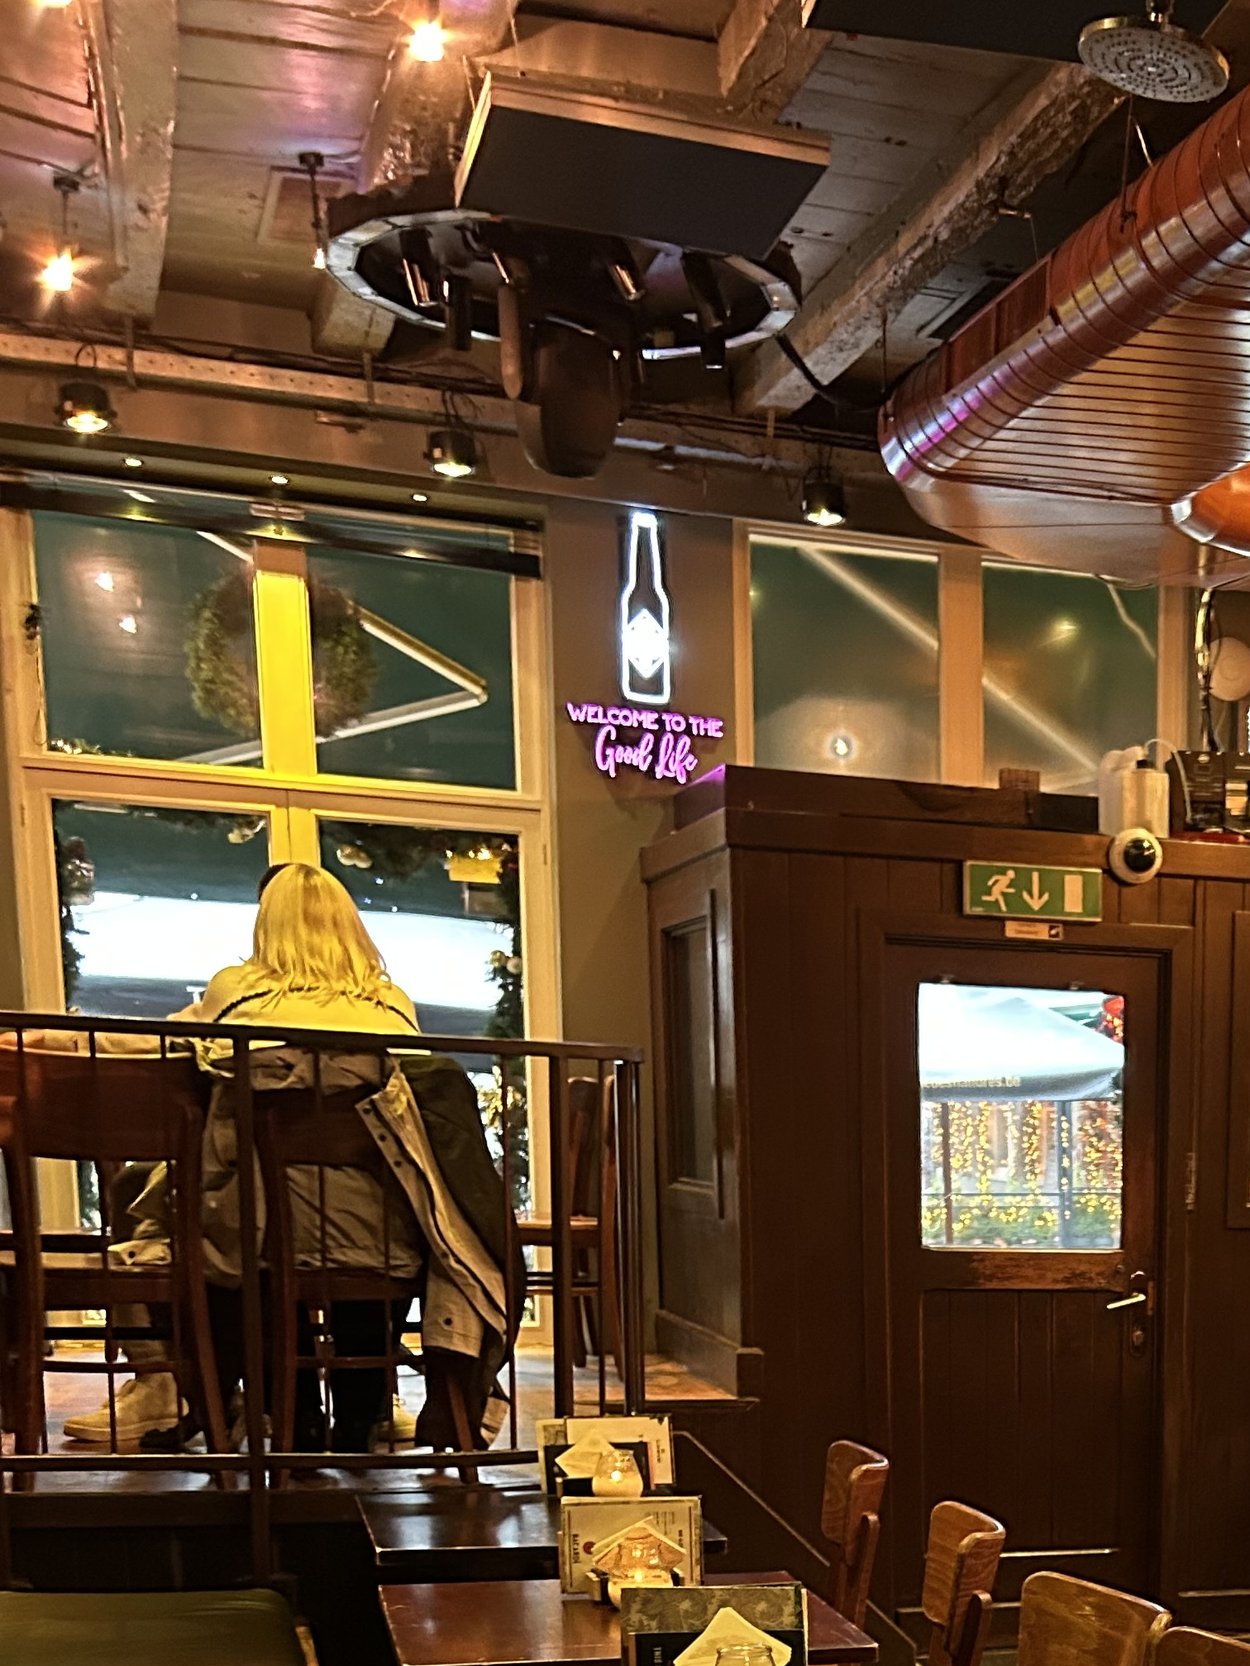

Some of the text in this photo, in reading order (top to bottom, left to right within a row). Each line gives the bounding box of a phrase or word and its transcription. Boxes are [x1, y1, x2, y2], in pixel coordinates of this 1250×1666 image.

[566, 702, 724, 738] WELCOME TO THE
[595, 724, 655, 778] Good
